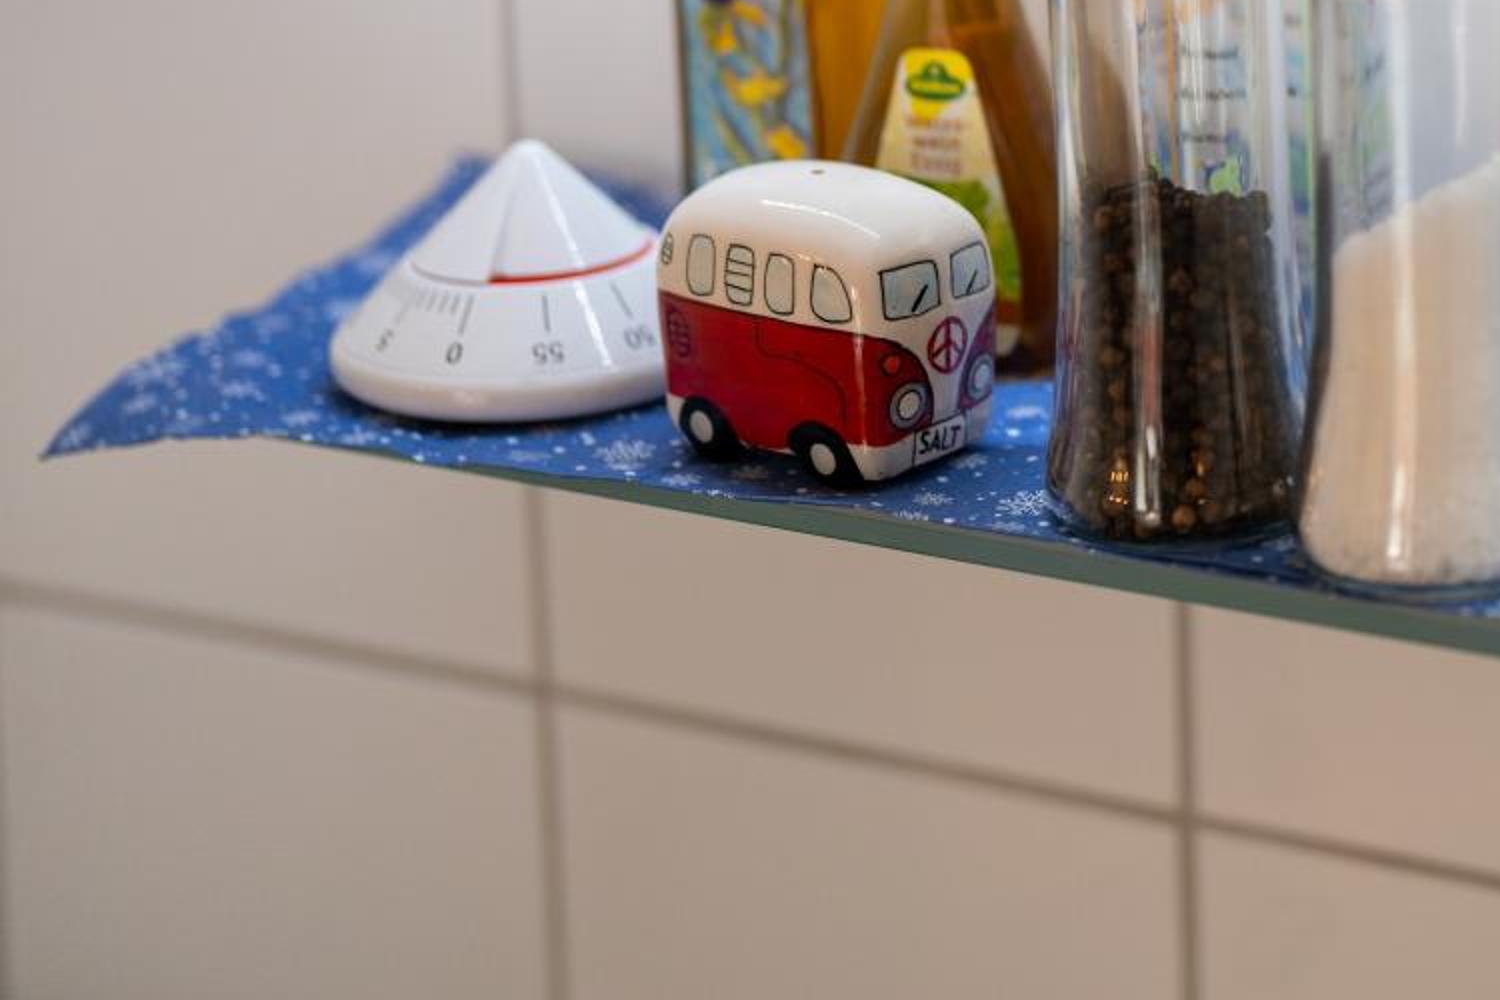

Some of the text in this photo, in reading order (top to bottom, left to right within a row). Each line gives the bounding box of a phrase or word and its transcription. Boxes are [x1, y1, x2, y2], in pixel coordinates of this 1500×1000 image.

[445, 341, 464, 365] 0
[531, 341, 565, 367] 55
[920, 424, 962, 455] SALT
